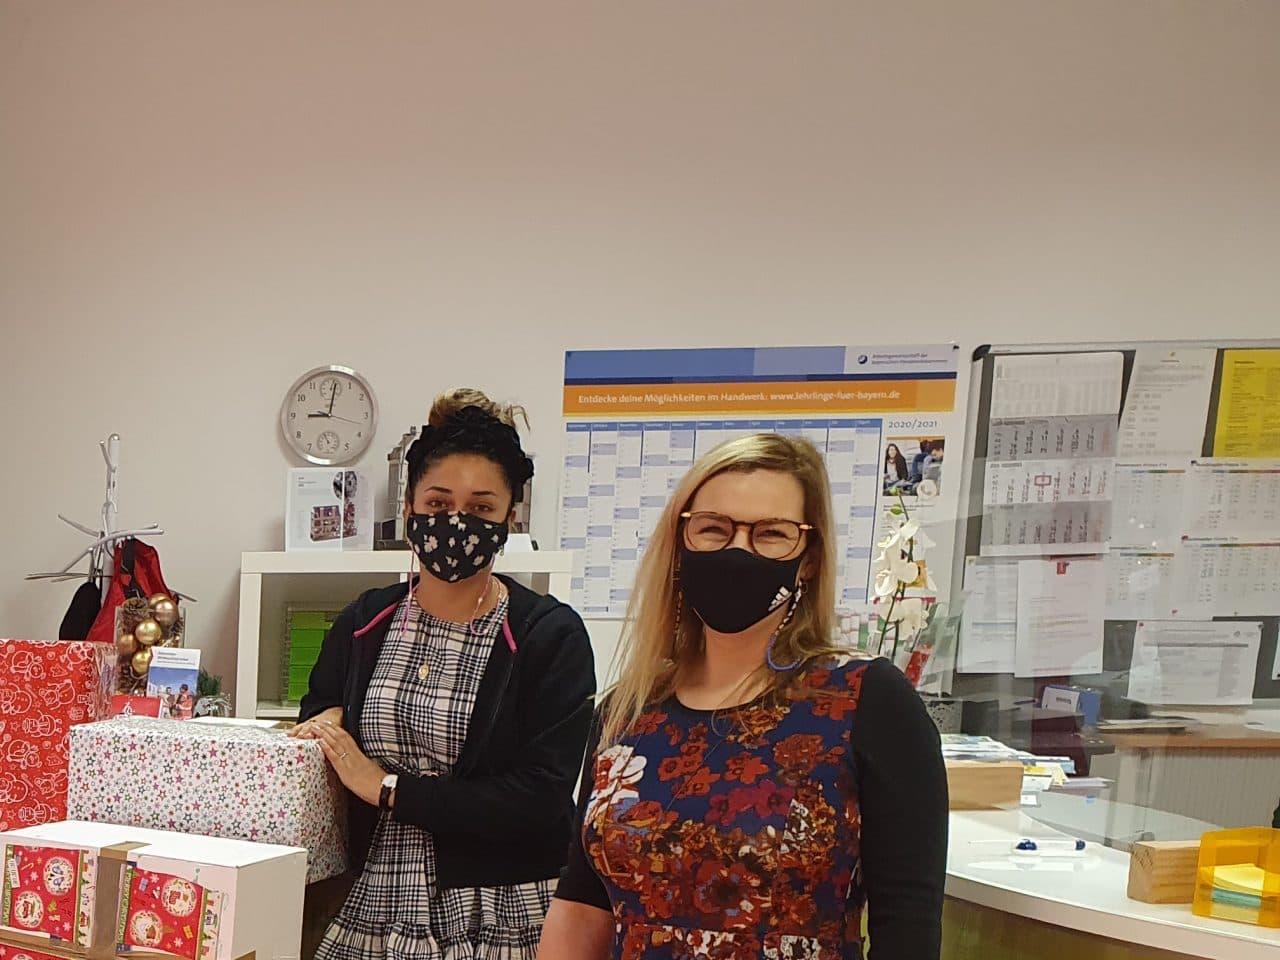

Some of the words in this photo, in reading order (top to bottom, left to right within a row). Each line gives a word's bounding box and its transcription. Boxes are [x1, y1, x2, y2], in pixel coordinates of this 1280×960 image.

[309, 382, 316, 390] 11
[297, 394, 306, 402] 10
[359, 393, 365, 401] 2
[578, 395, 617, 404] Entdecke
[619, 394, 642, 403] deine
[644, 393, 706, 405] Möglichkeiten
[707, 393, 719, 401] im
[290, 412, 296, 420] 9
[364, 412, 369, 420] 3
[888, 420, 938, 429] 2020/2021
[296, 430, 302, 439] 8
[356, 431, 362, 439] 4
[307, 443, 313, 451] 7
[344, 443, 350, 451] 5
